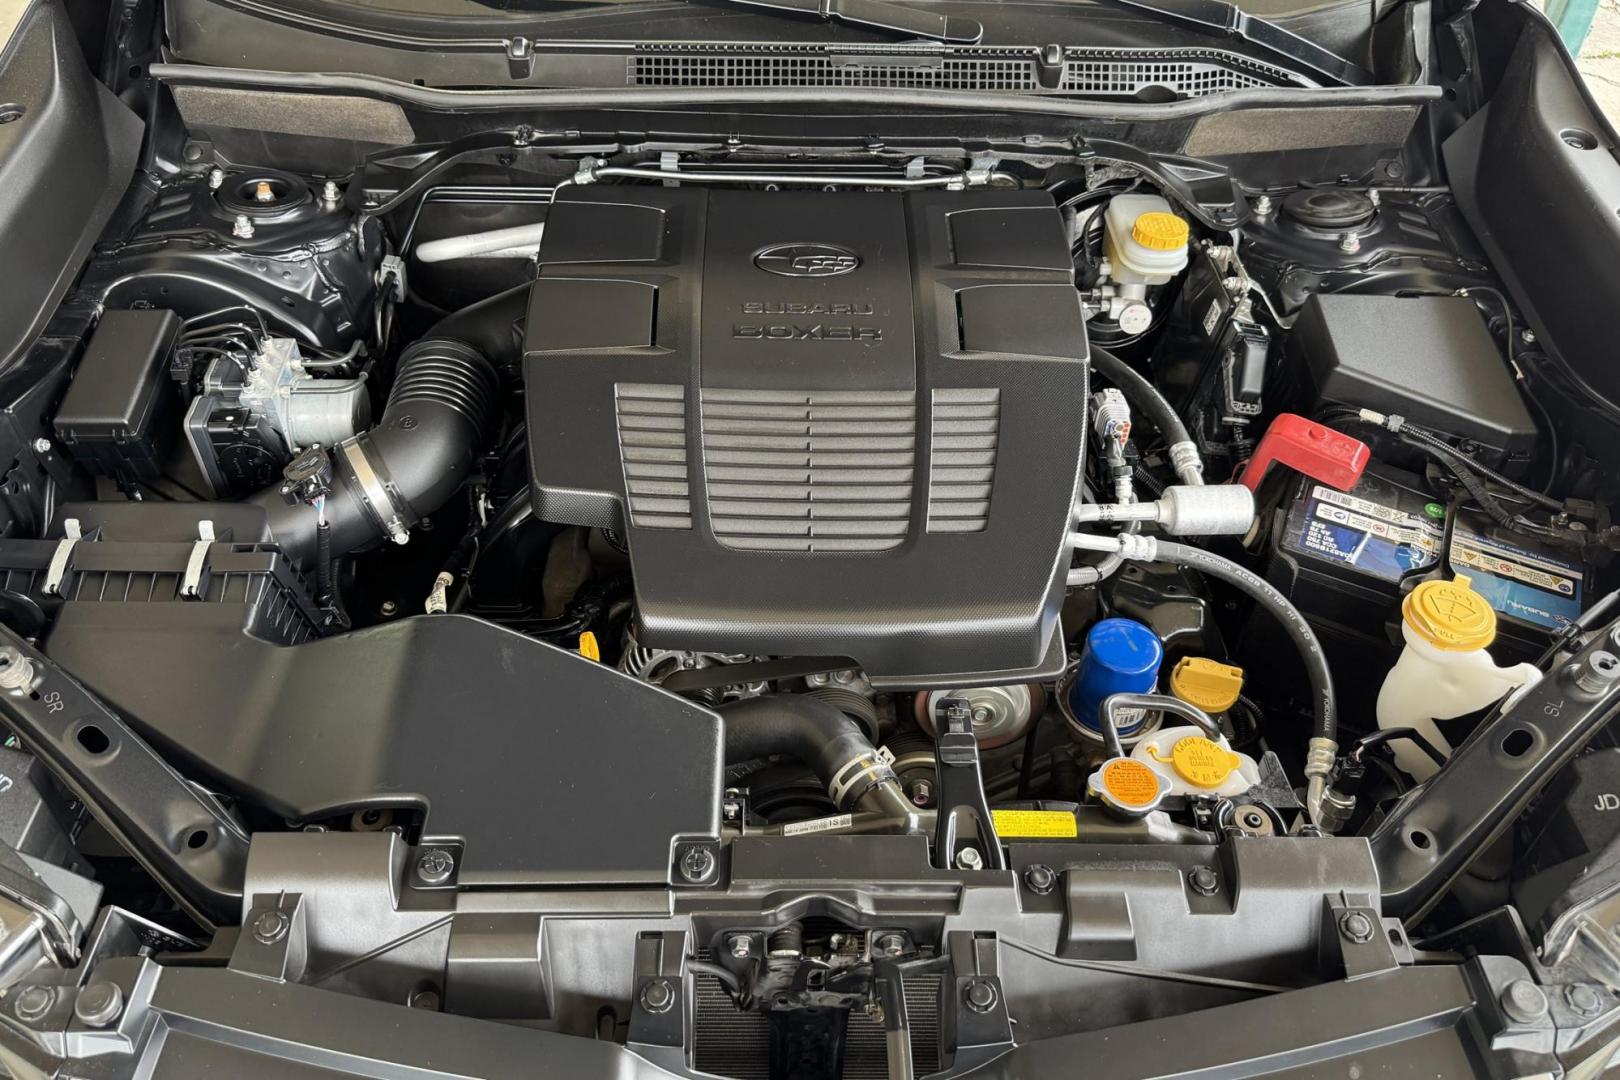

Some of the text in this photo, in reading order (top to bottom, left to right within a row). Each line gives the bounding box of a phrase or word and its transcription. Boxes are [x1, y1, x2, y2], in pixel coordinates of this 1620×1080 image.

[743, 302, 873, 315] SUBARU
[733, 324, 882, 341] BOXER
[1507, 600, 1550, 618] SUBARU
[43, 691, 64, 714] SR
[1543, 700, 1564, 717] SL
[1594, 793, 1620, 811] JD
